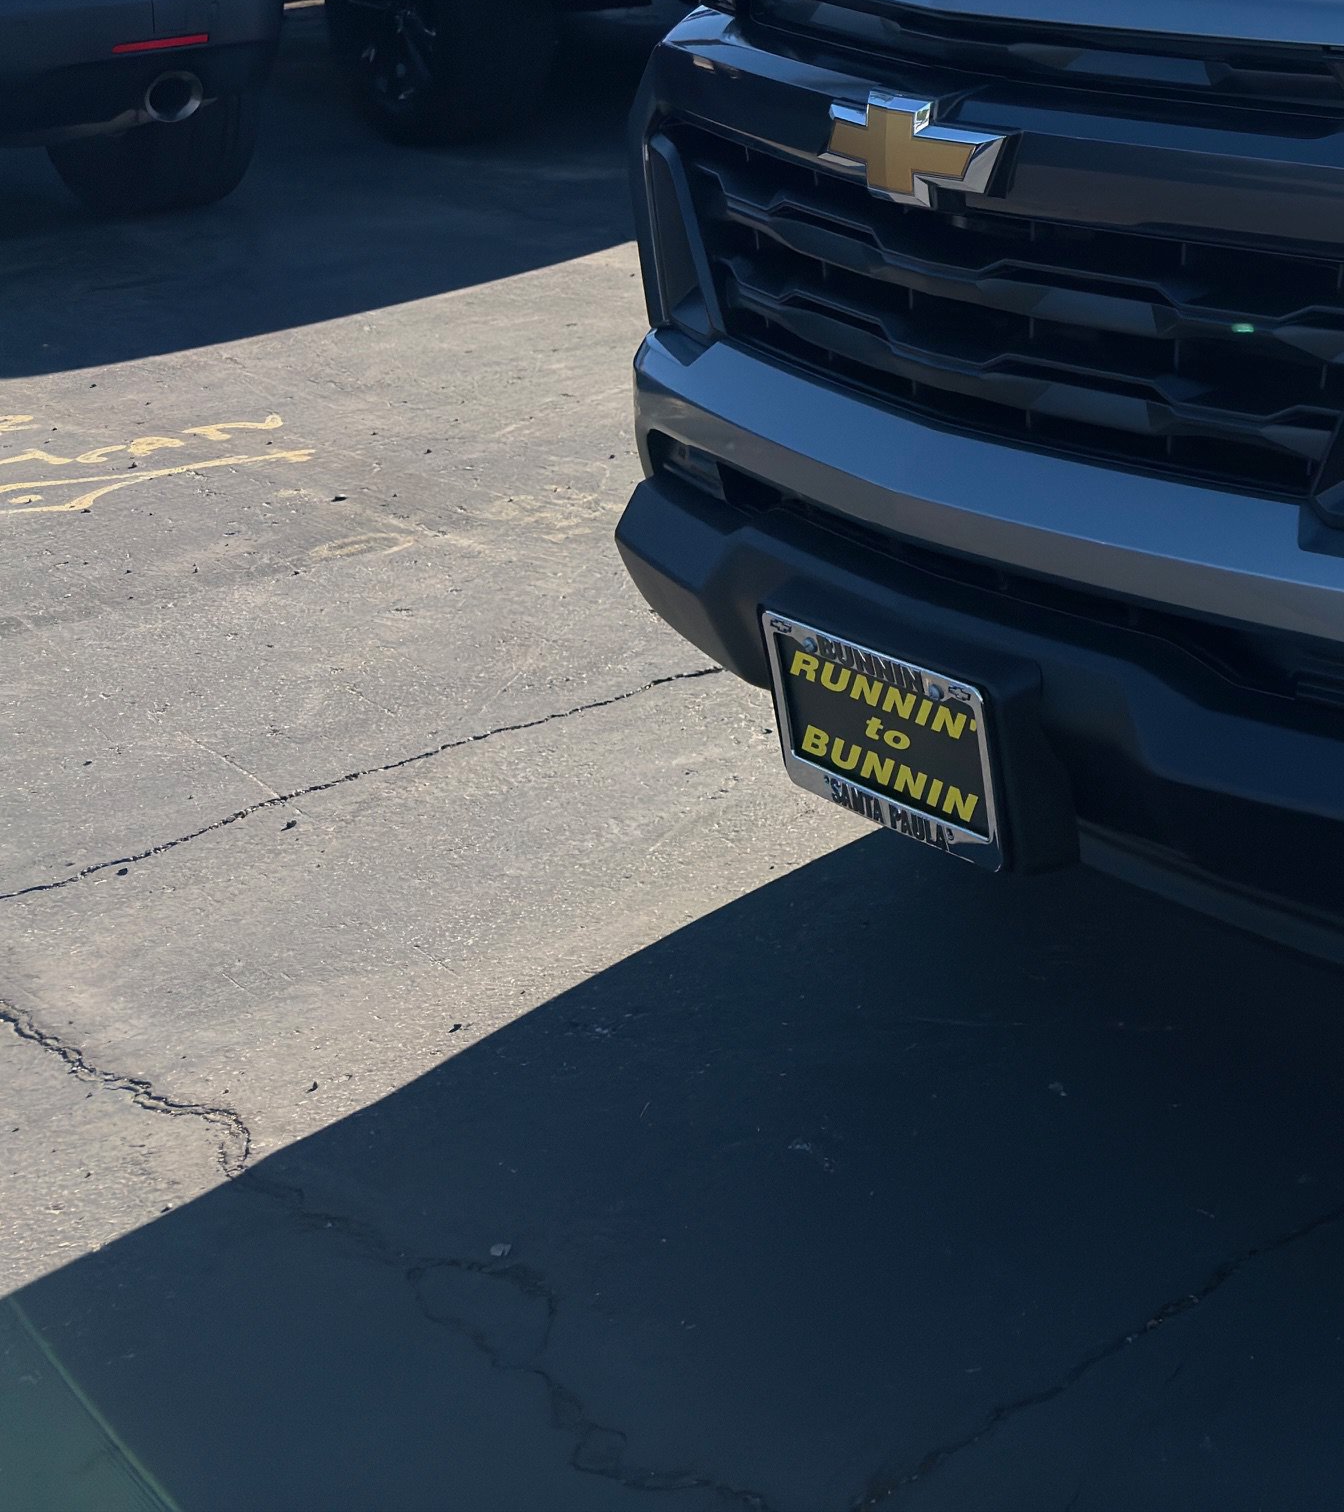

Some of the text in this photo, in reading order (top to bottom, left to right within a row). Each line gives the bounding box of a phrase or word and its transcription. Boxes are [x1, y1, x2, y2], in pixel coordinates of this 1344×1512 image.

[789, 650, 977, 740] RUNNIN'
[816, 634, 927, 695] BUNNIN
[864, 716, 911, 750] to
[801, 724, 978, 822] BUNNIN
